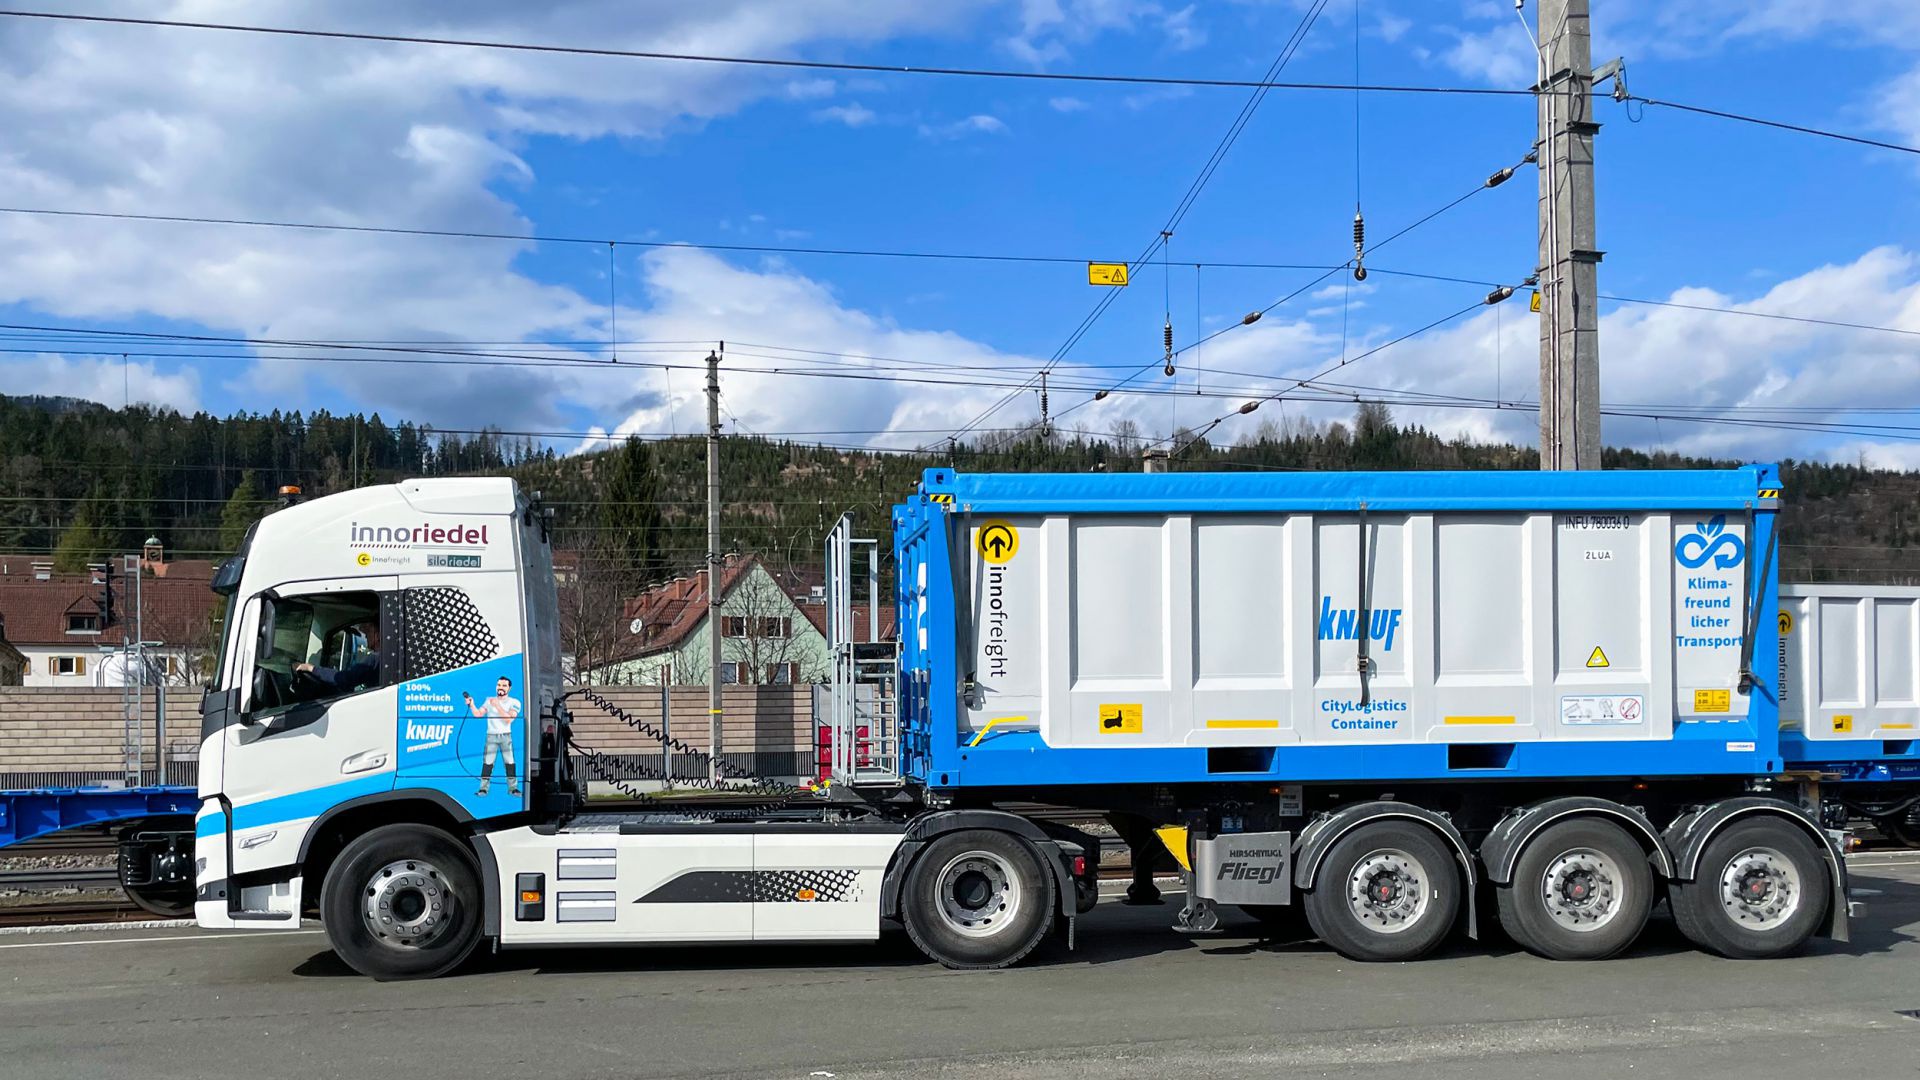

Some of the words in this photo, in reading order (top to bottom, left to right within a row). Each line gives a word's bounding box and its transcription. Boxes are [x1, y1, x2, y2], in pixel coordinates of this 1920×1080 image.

[1565, 515, 1588, 529] INFU
[1591, 515, 1621, 529] 780036
[351, 521, 489, 545] innoriedel
[1585, 551, 1611, 560] 2LUA
[1688, 577, 1733, 589] Klima-
[1685, 596, 1731, 609] freund
[985, 566, 1008, 677] innofreight
[1691, 615, 1730, 628] licher
[406, 683, 431, 692] 100%
[405, 693, 451, 702] elektrisch
[405, 704, 454, 714] unterwegs
[1321, 699, 1407, 714] CityLogistics
[1331, 717, 1398, 730] Container
[405, 719, 454, 745] KNAUF
[1217, 862, 1284, 885] Fliegl
